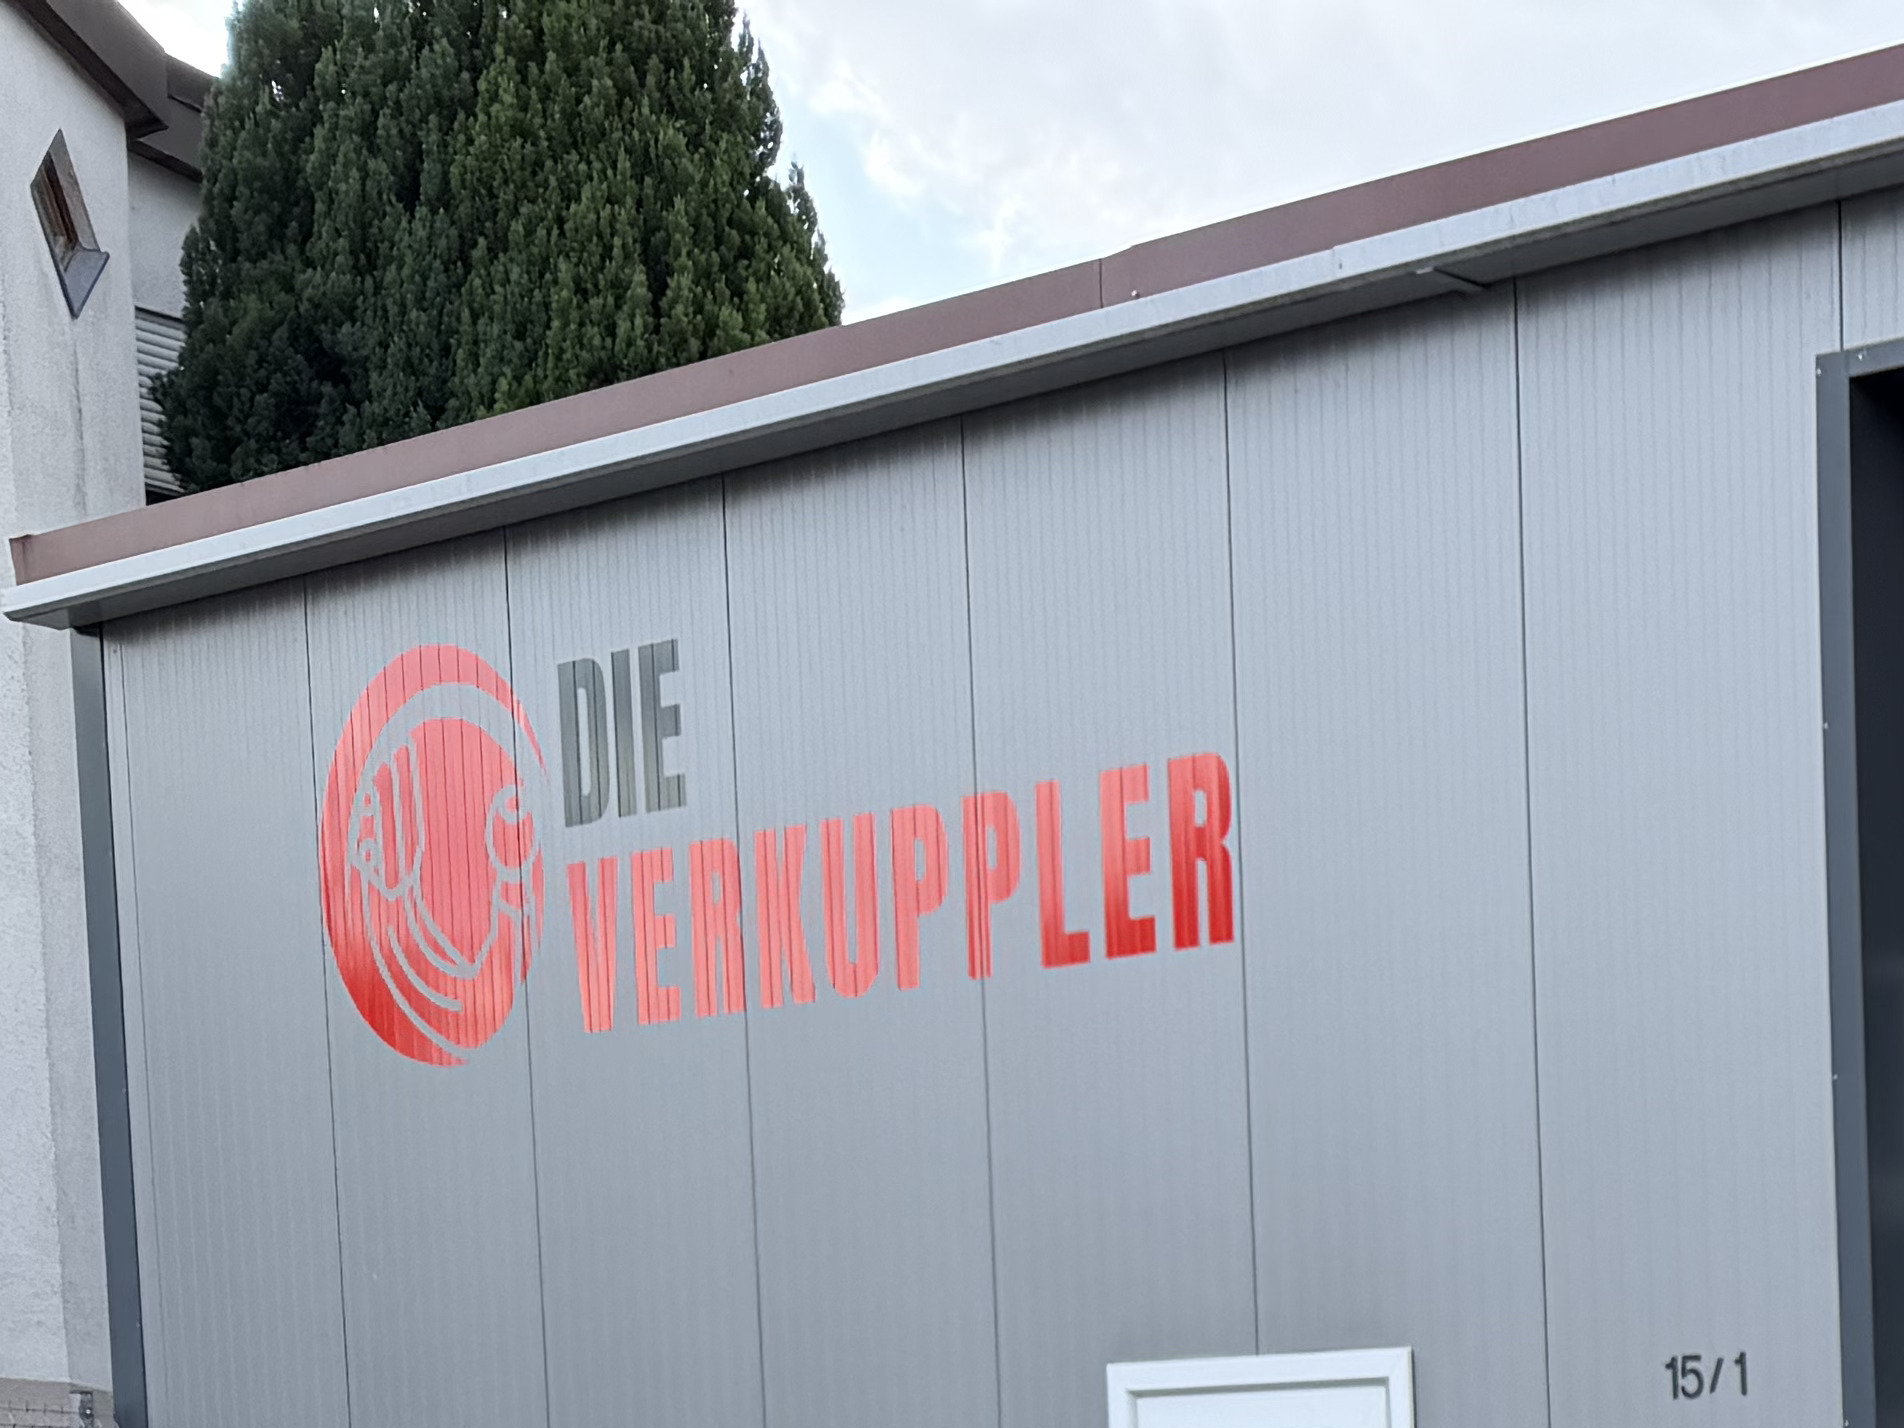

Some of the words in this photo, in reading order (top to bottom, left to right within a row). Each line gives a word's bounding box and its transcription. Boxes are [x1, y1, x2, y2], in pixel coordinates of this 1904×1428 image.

[557, 638, 687, 828] DIE
[565, 751, 1235, 1034] VERKUPPLER
[1665, 1352, 1747, 1400] 15/1
